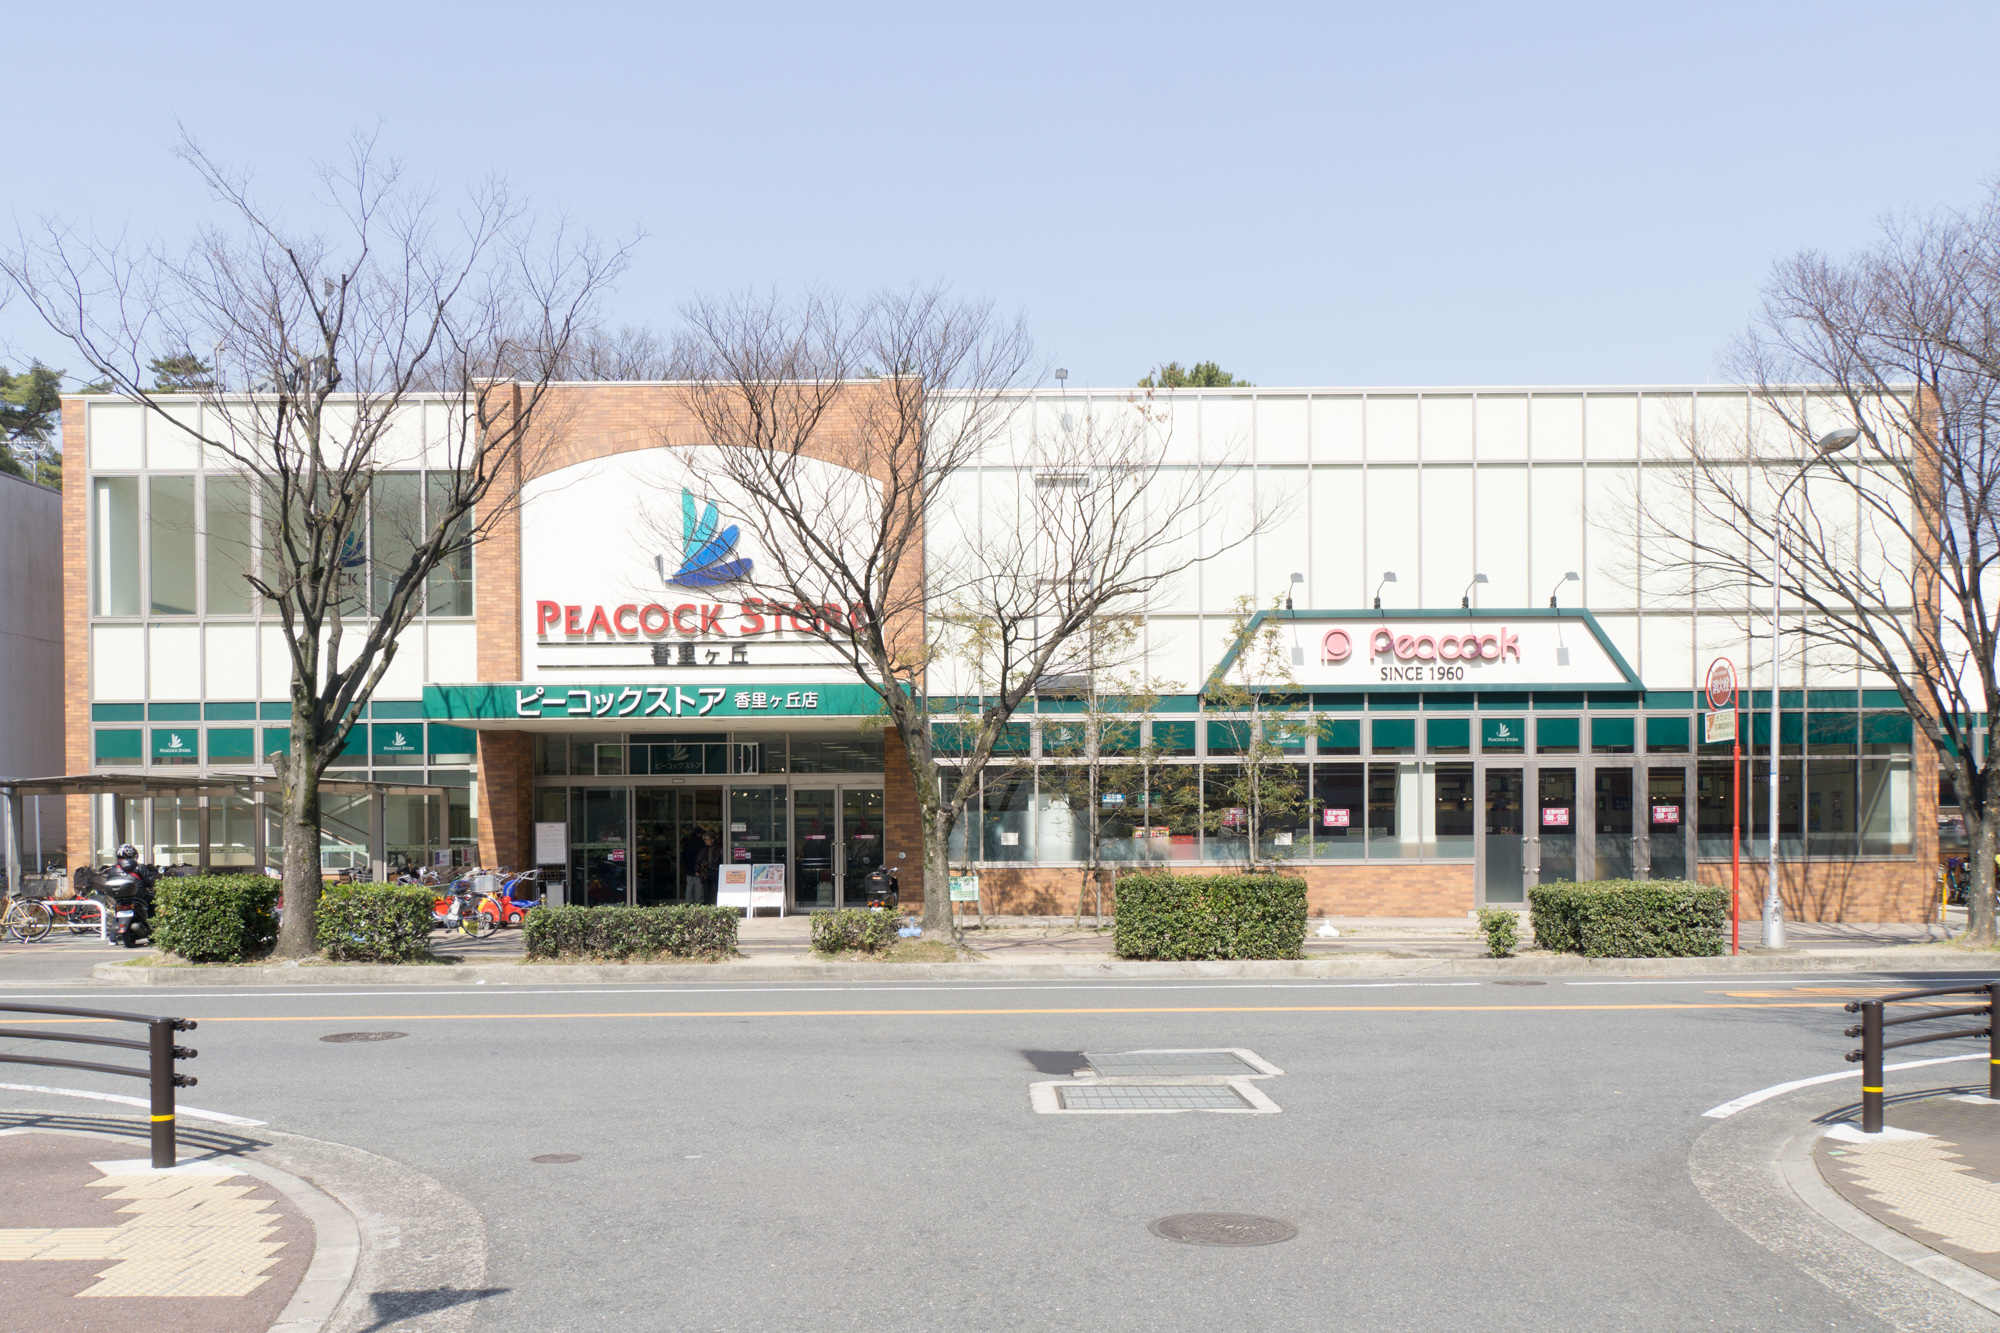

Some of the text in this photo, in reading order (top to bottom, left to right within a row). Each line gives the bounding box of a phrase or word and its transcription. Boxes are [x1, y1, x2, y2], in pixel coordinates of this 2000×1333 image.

[536, 600, 727, 635] PEACOCK
[1370, 627, 1521, 661] Peacock
[1380, 666, 1464, 681] SINCE 1960
[1712, 676, 1730, 695] 消火栓
[516, 686, 726, 717] ピーコックストア
